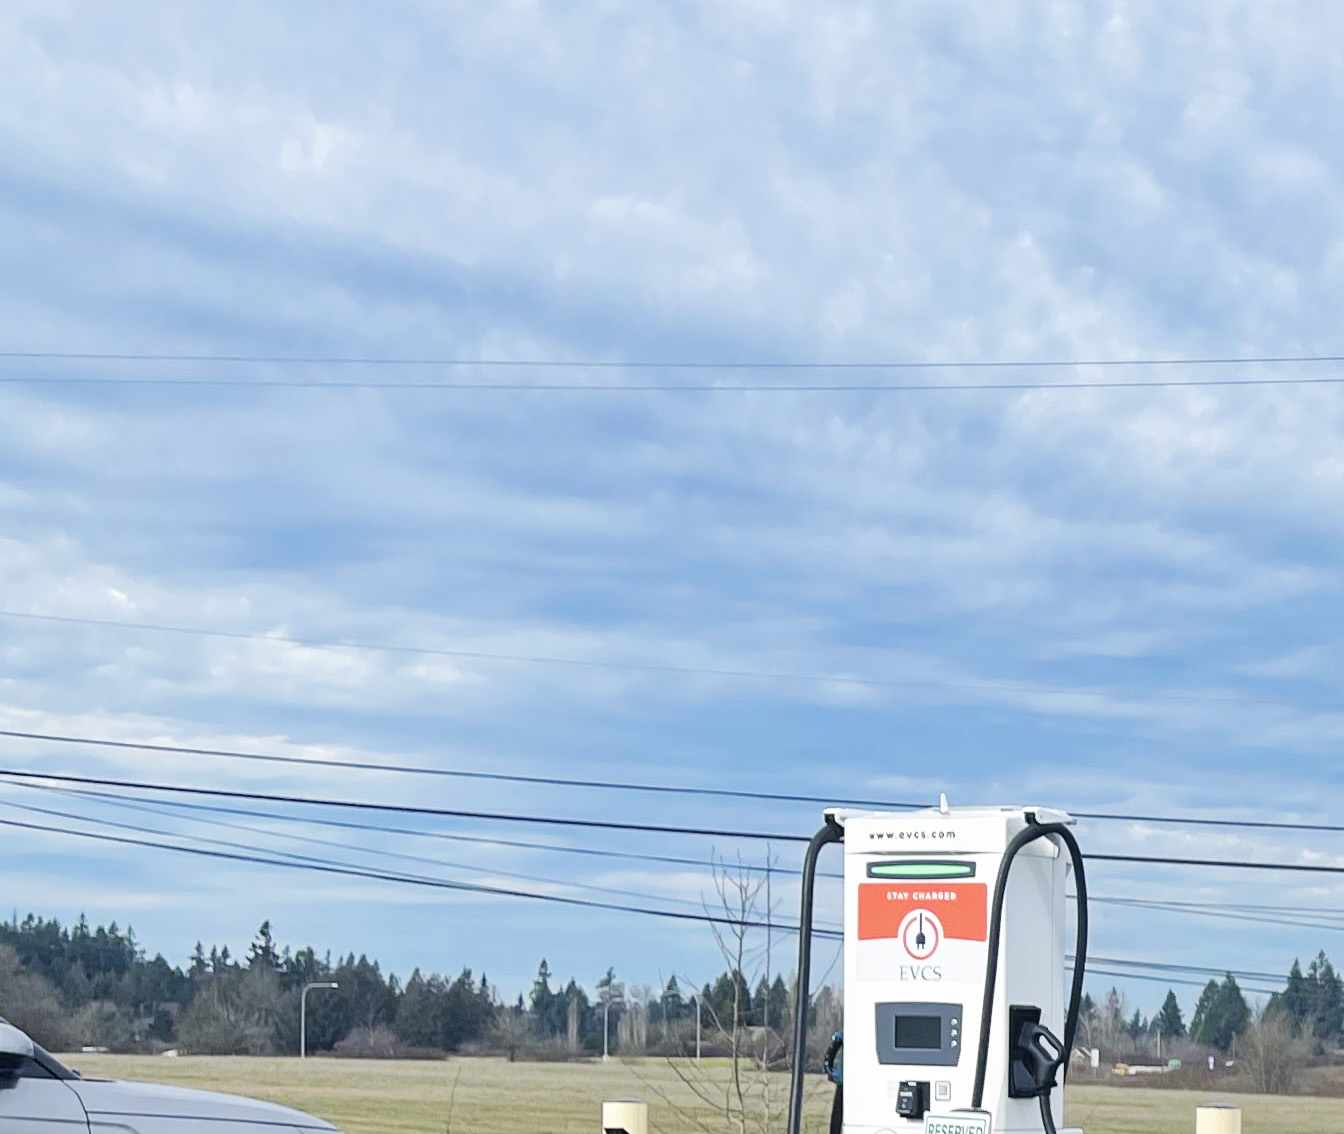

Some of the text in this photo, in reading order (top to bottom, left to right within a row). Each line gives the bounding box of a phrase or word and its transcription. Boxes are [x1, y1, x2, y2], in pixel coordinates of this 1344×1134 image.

[868, 831, 957, 840] www.evcs.com
[886, 891, 957, 901] STAY CHARGED
[899, 965, 942, 981] EVCS
